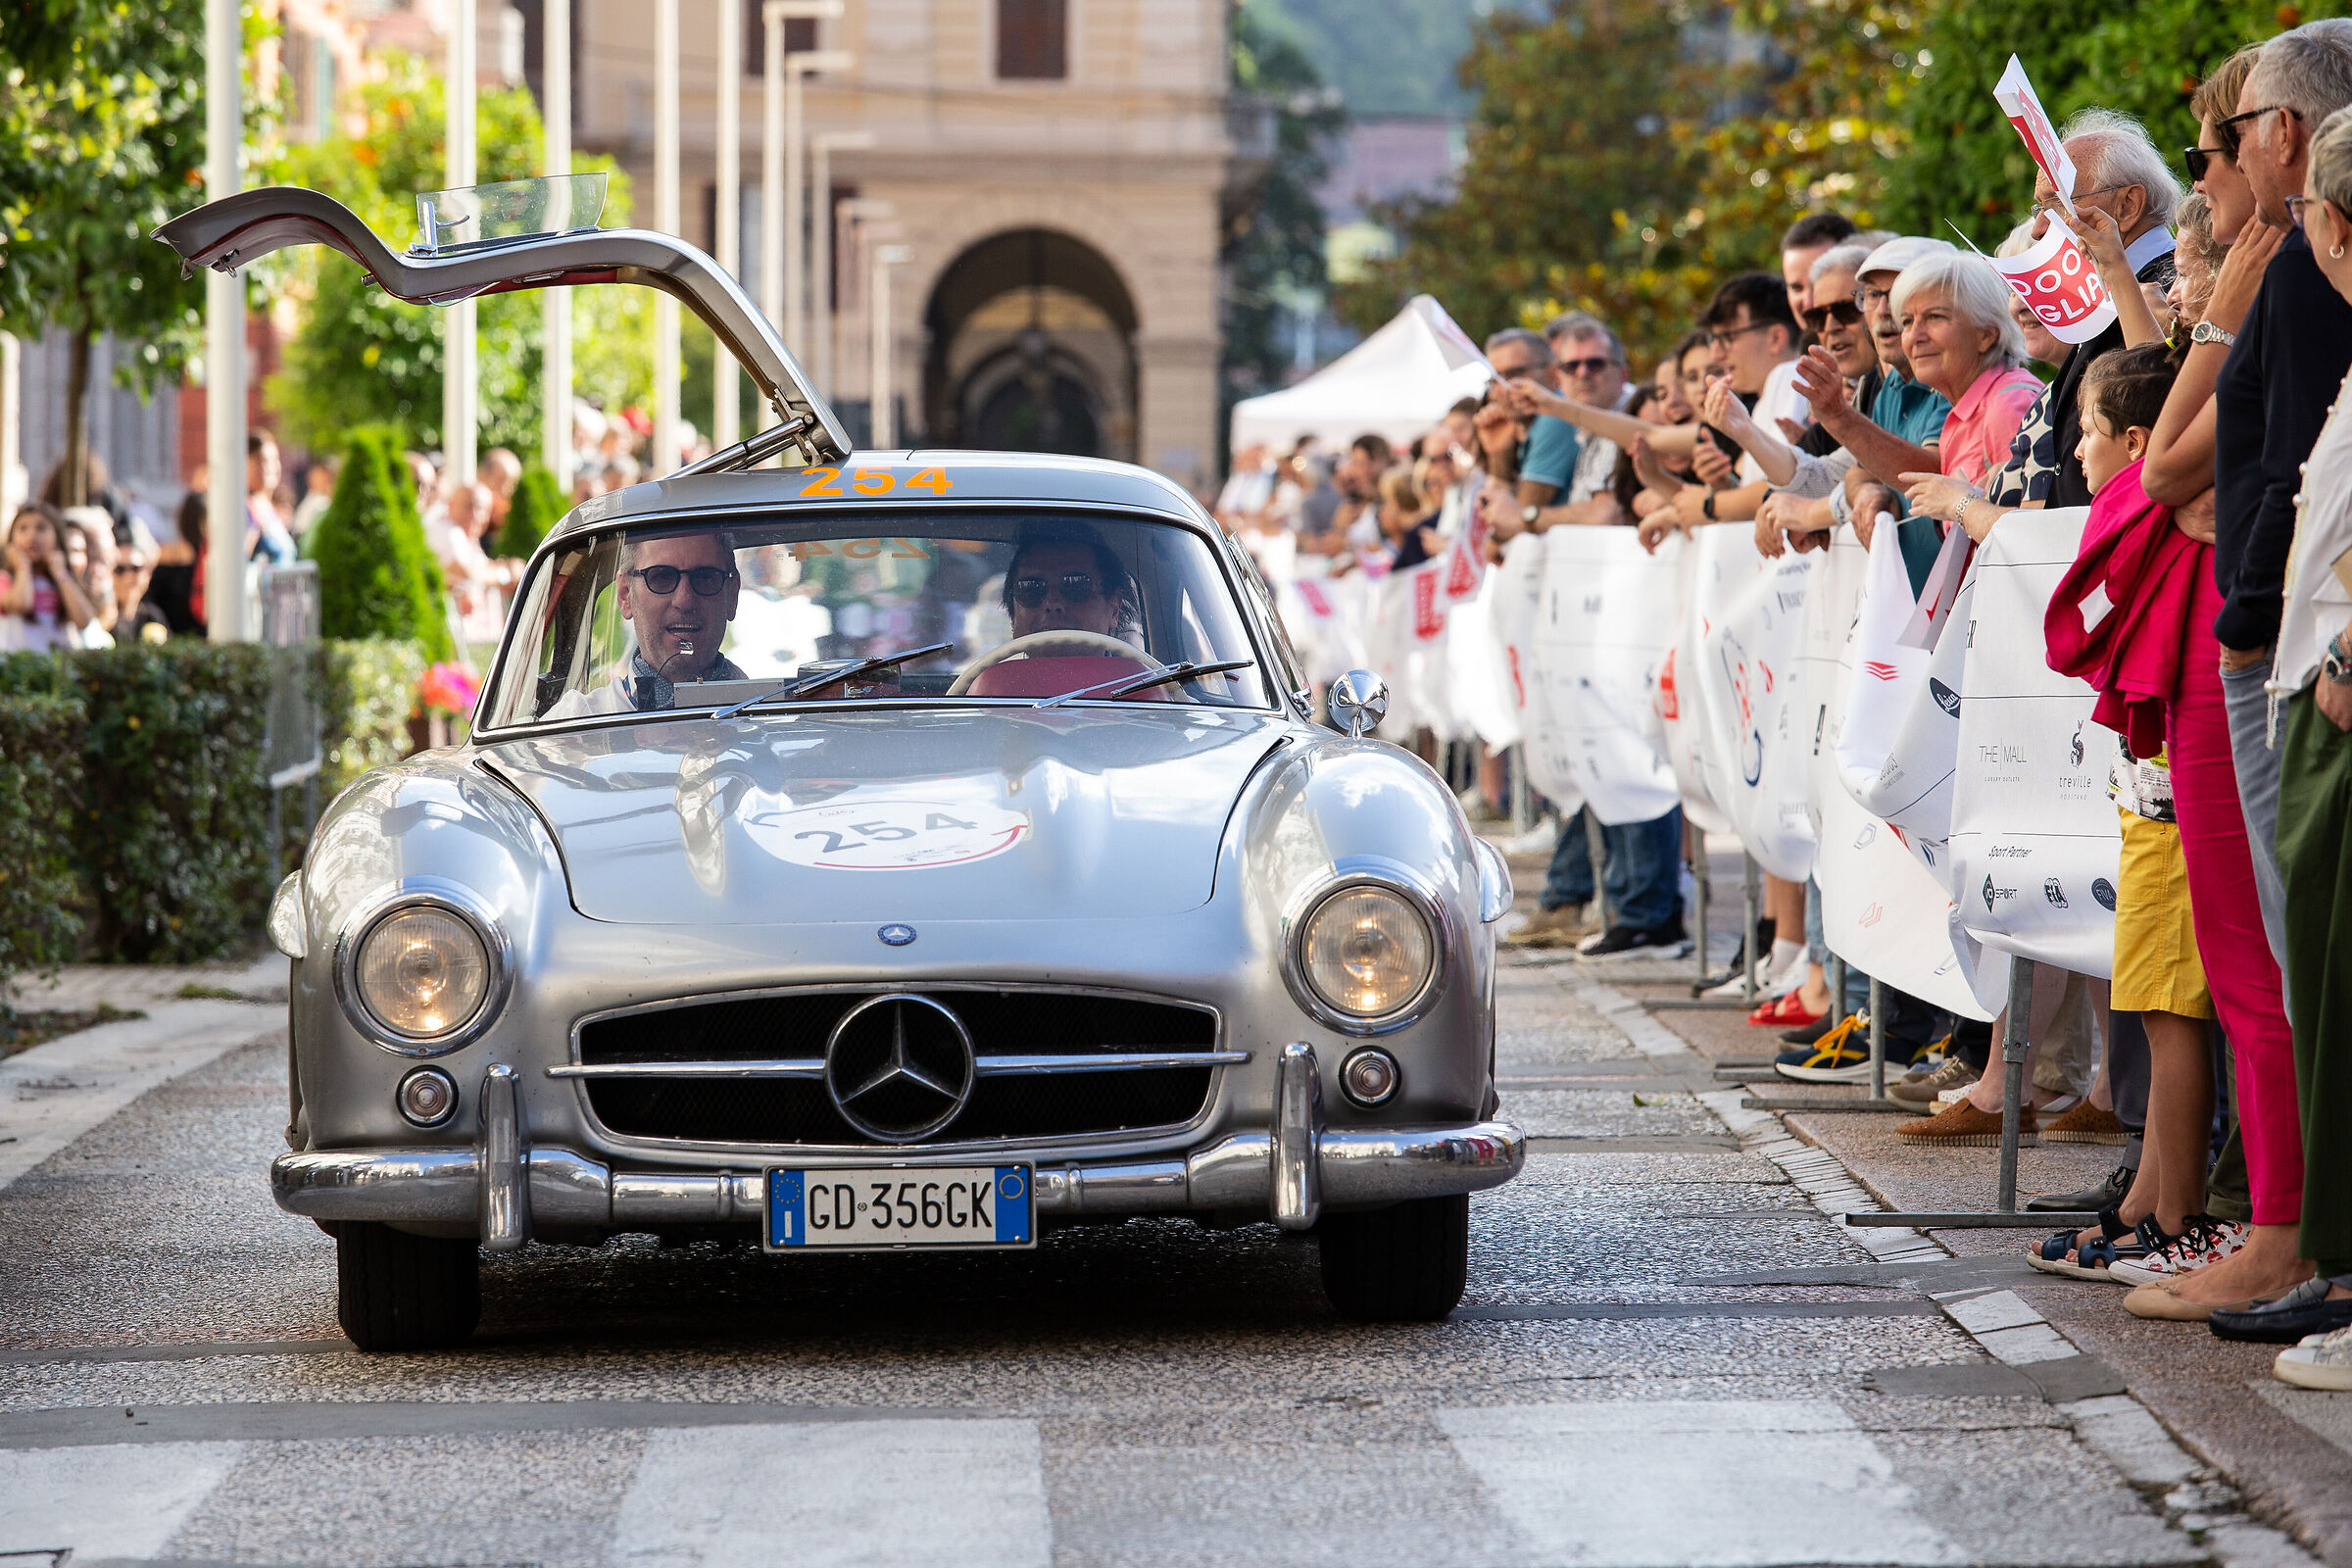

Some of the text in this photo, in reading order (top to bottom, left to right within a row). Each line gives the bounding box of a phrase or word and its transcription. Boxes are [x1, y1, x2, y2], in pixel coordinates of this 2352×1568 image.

[2006, 248, 2082, 297] 000
[2034, 272, 2111, 322] GLIA
[800, 466, 954, 497] 254
[1979, 745, 2028, 763] THE MALL
[2059, 775, 2092, 788] treville
[794, 812, 979, 854] 254
[1988, 845, 2033, 859] Sport Partner
[1995, 888, 2018, 900] SPORT
[2096, 889, 2115, 902] FIVA
[808, 1182, 993, 1230] GD 356GK
